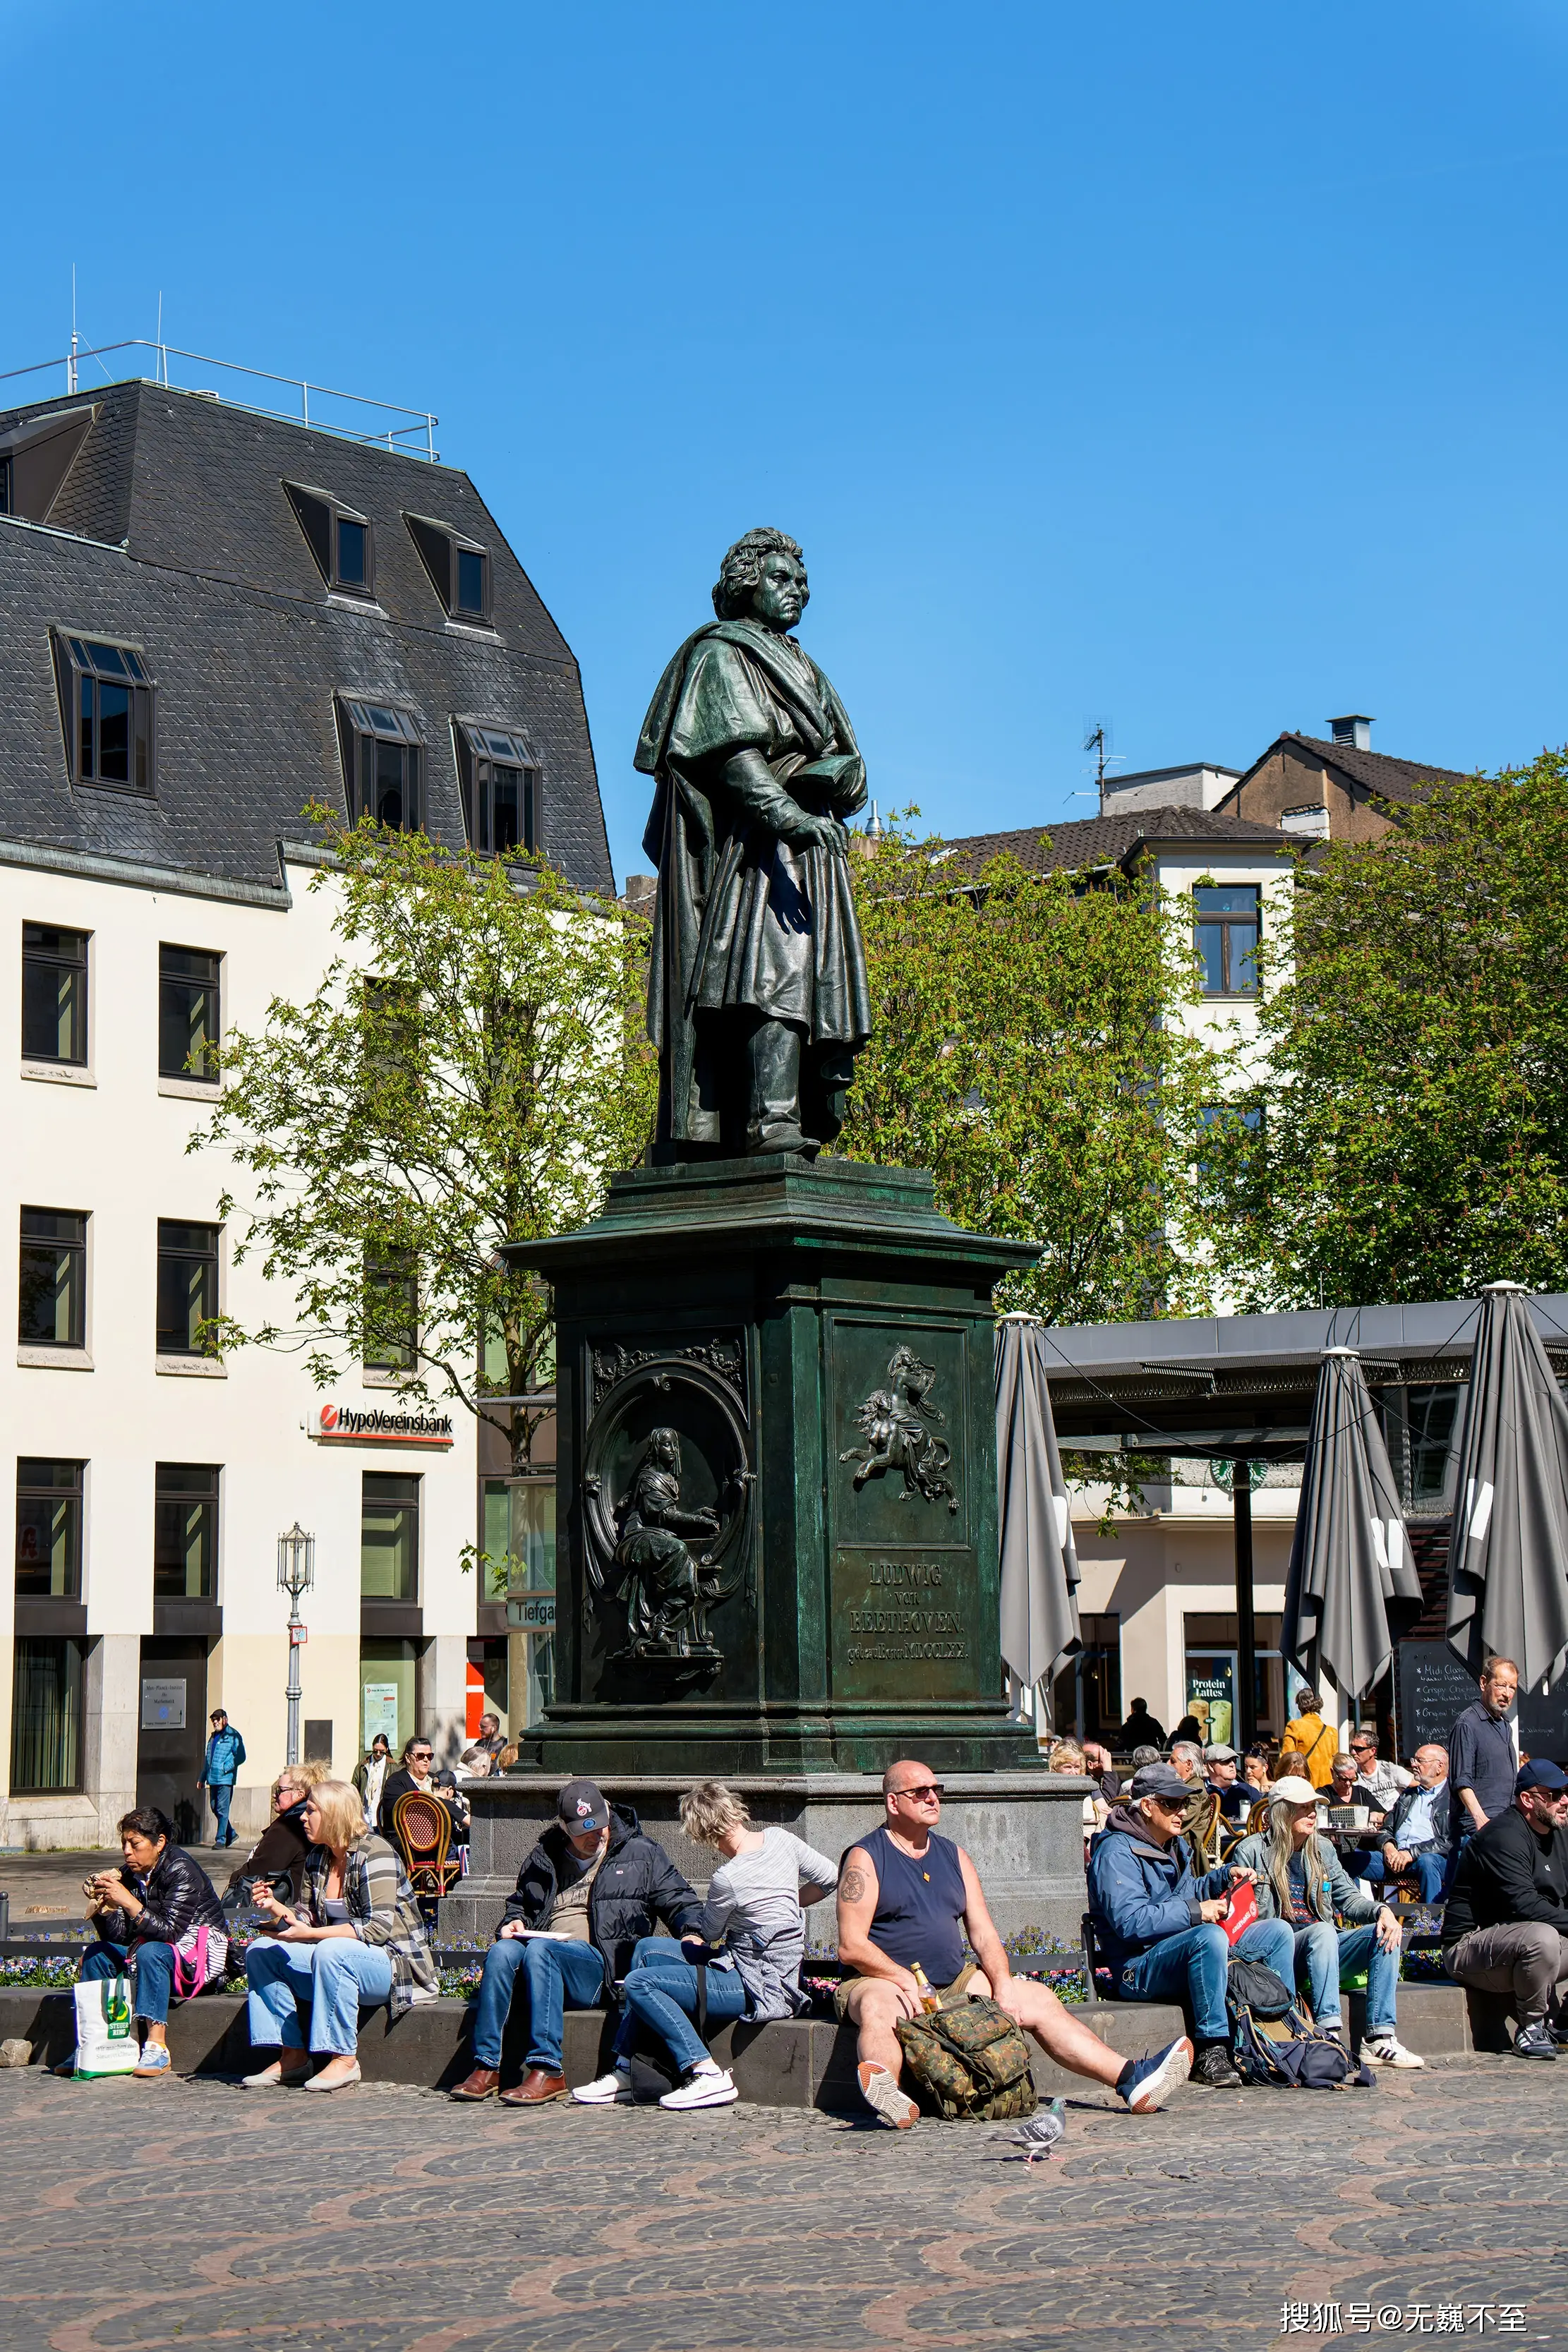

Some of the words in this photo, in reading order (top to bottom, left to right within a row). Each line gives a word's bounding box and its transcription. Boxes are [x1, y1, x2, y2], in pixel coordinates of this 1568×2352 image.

[339, 1407, 452, 1433] HypoVereinsbank
[869, 1563, 942, 1586] LUDWIG
[516, 1600, 556, 1625] Tiefga
[850, 1610, 965, 1634] BEETHOVEN.
[1193, 1679, 1226, 1689] Protein
[1195, 1688, 1223, 1697] Lattes
[1423, 1685, 1446, 1696] Crispy
[1423, 1708, 1447, 1721] Original
